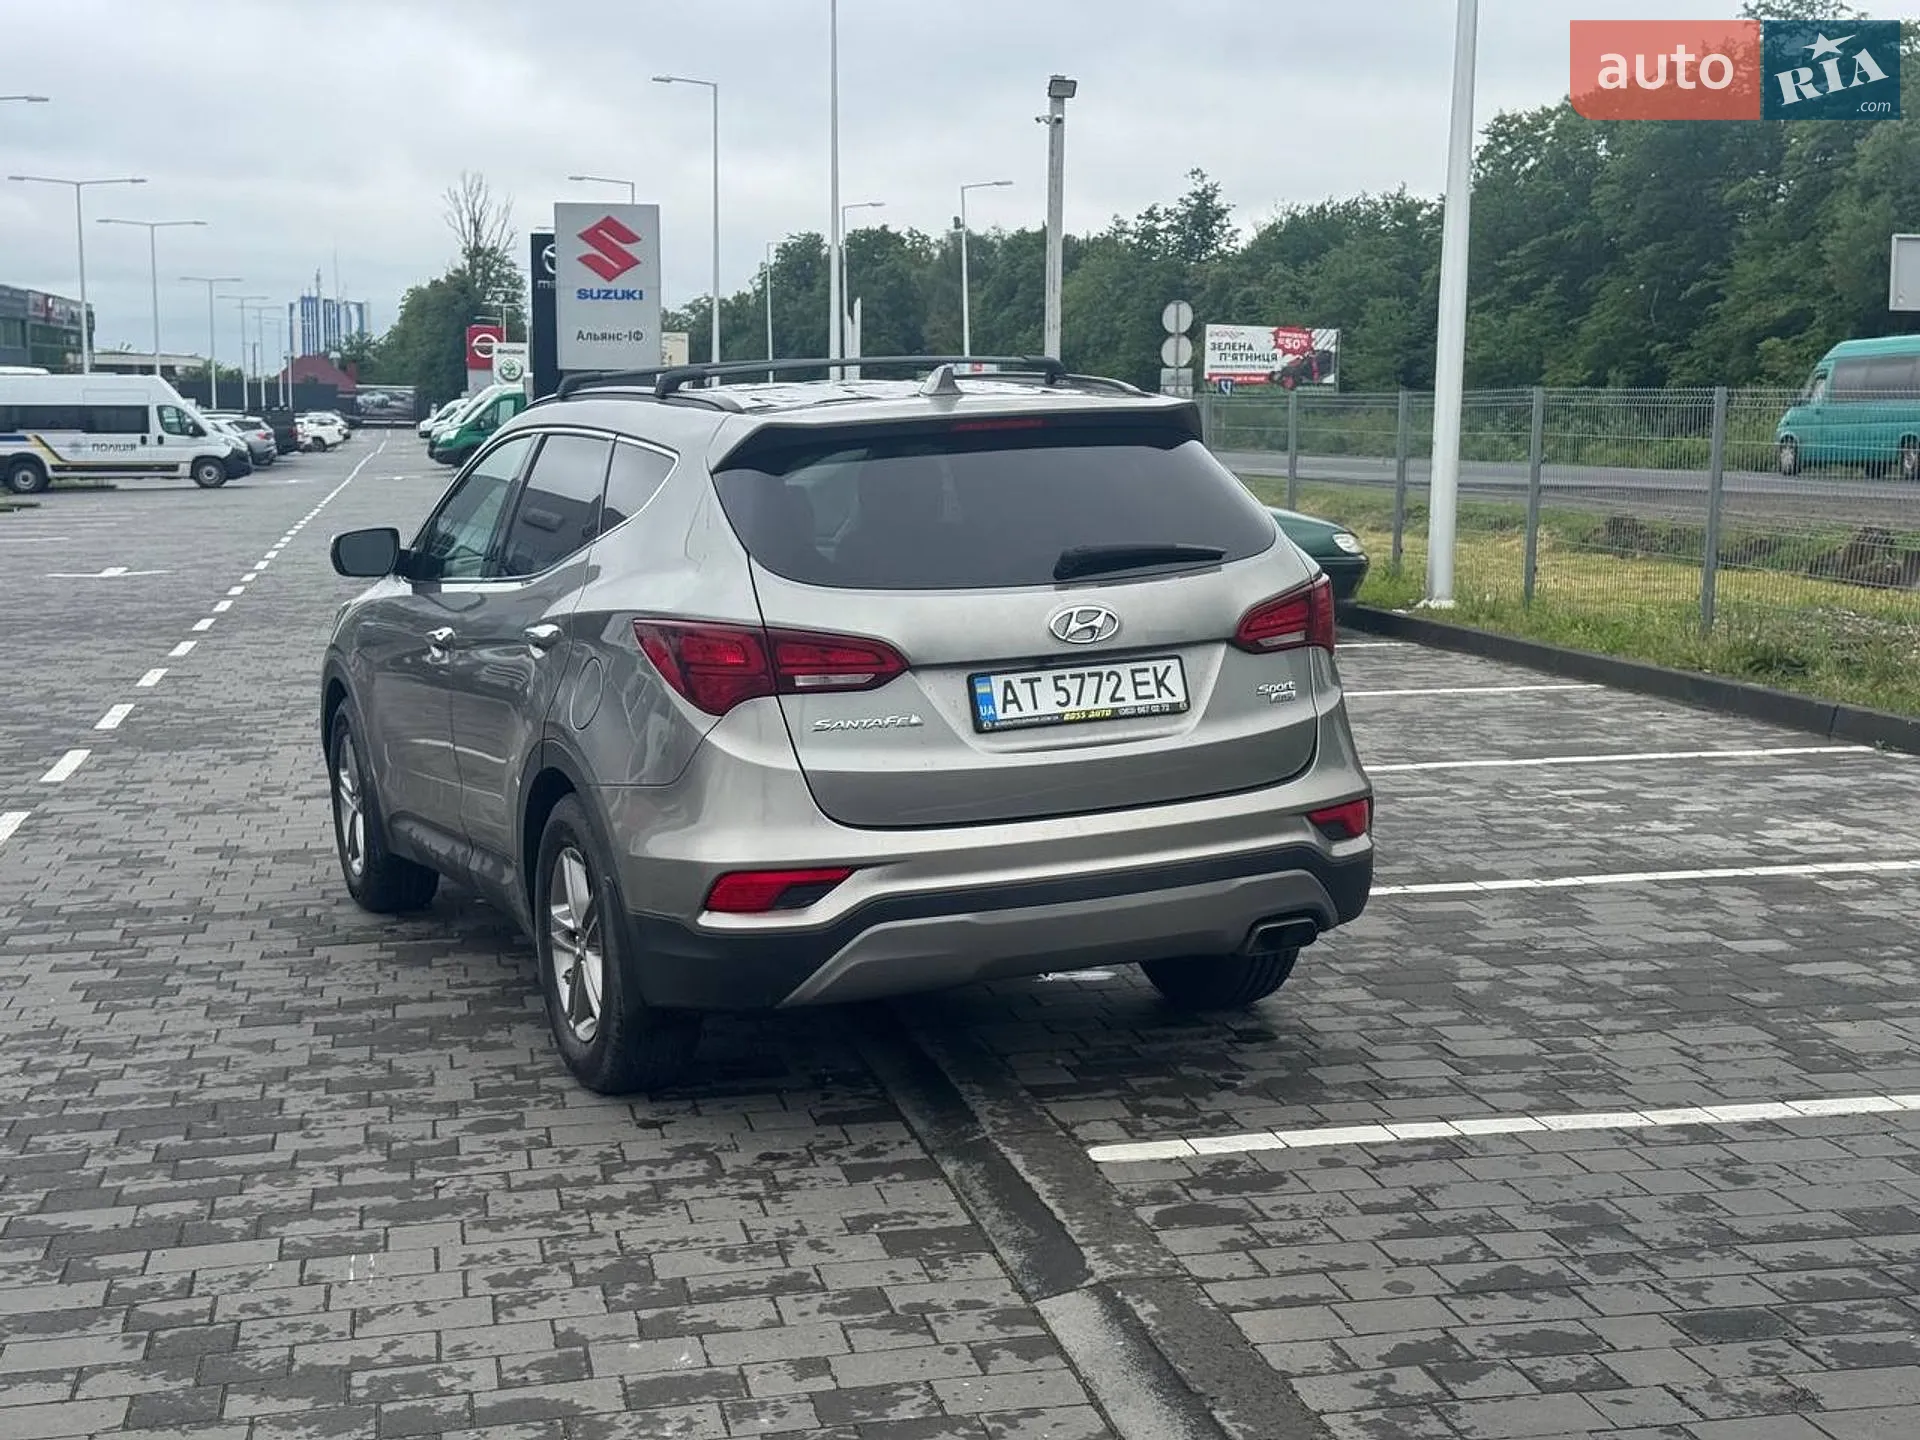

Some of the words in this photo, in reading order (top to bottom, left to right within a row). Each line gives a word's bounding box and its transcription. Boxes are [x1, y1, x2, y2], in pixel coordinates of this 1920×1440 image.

[576, 288, 643, 300] SUZUKI
[1210, 342, 1254, 351] ЗЕЛЕНА
[1001, 677, 1042, 713] AT
[1053, 670, 1126, 708] 5772
[1131, 664, 1177, 700] EK
[979, 704, 995, 716] UA
